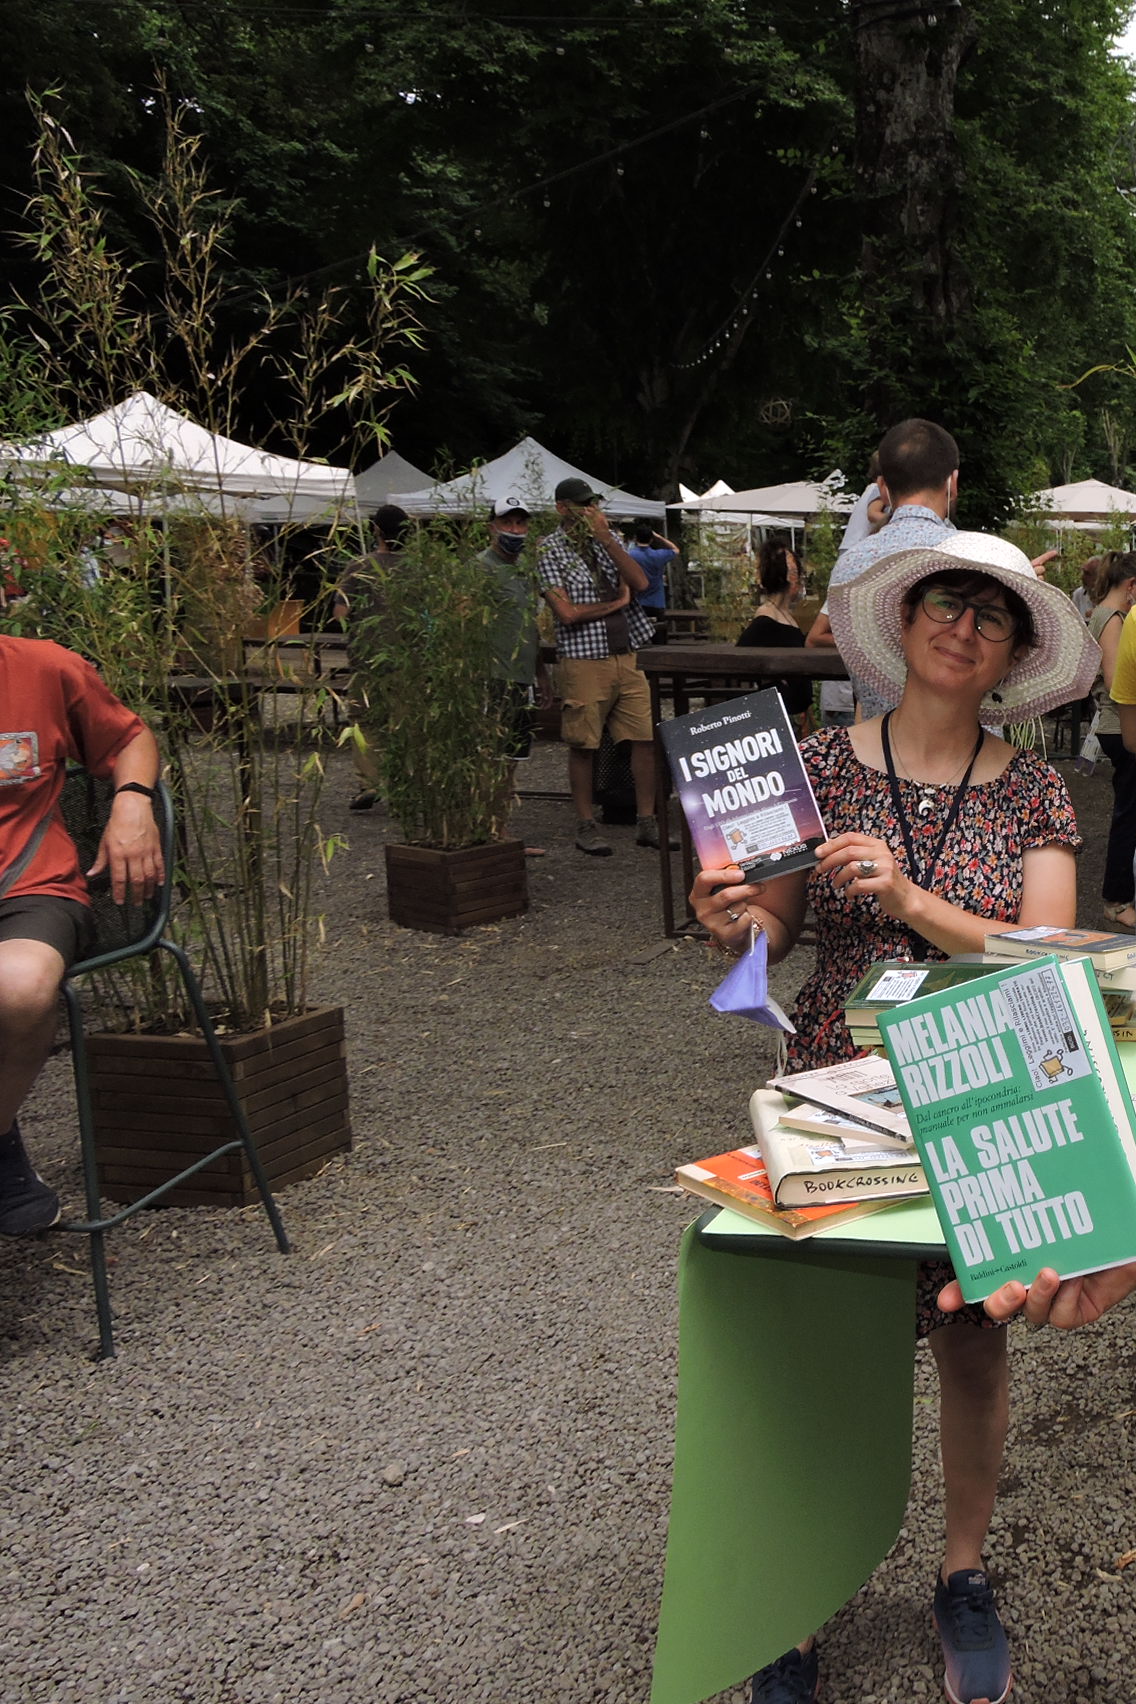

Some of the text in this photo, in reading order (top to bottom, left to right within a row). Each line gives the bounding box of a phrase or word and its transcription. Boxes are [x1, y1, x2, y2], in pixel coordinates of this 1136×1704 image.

[690, 710, 751, 736] Roberto Pinotti
[679, 728, 783, 782] I SIGNORI
[726, 767, 749, 783] DEL
[702, 771, 785, 818] MONDO
[887, 989, 1015, 1066] MELANIA
[1004, 988, 1020, 1026] Rilasciami
[1020, 1034, 1035, 1064] Leggimi
[900, 1036, 1013, 1108] RIZZOLI
[1031, 1067, 1043, 1088] Ciao!
[916, 1086, 1021, 1125] Dal cancro all'ipocondria:
[919, 1093, 1034, 1134] manuale per non ammalarsi
[924, 1135, 969, 1183] LA
[970, 1098, 1084, 1169] SALUTE
[803, 1172, 918, 1194] BOOKCROSSING
[939, 1158, 1045, 1225] PRIMA
[953, 1190, 1094, 1267] DI TUTTO
